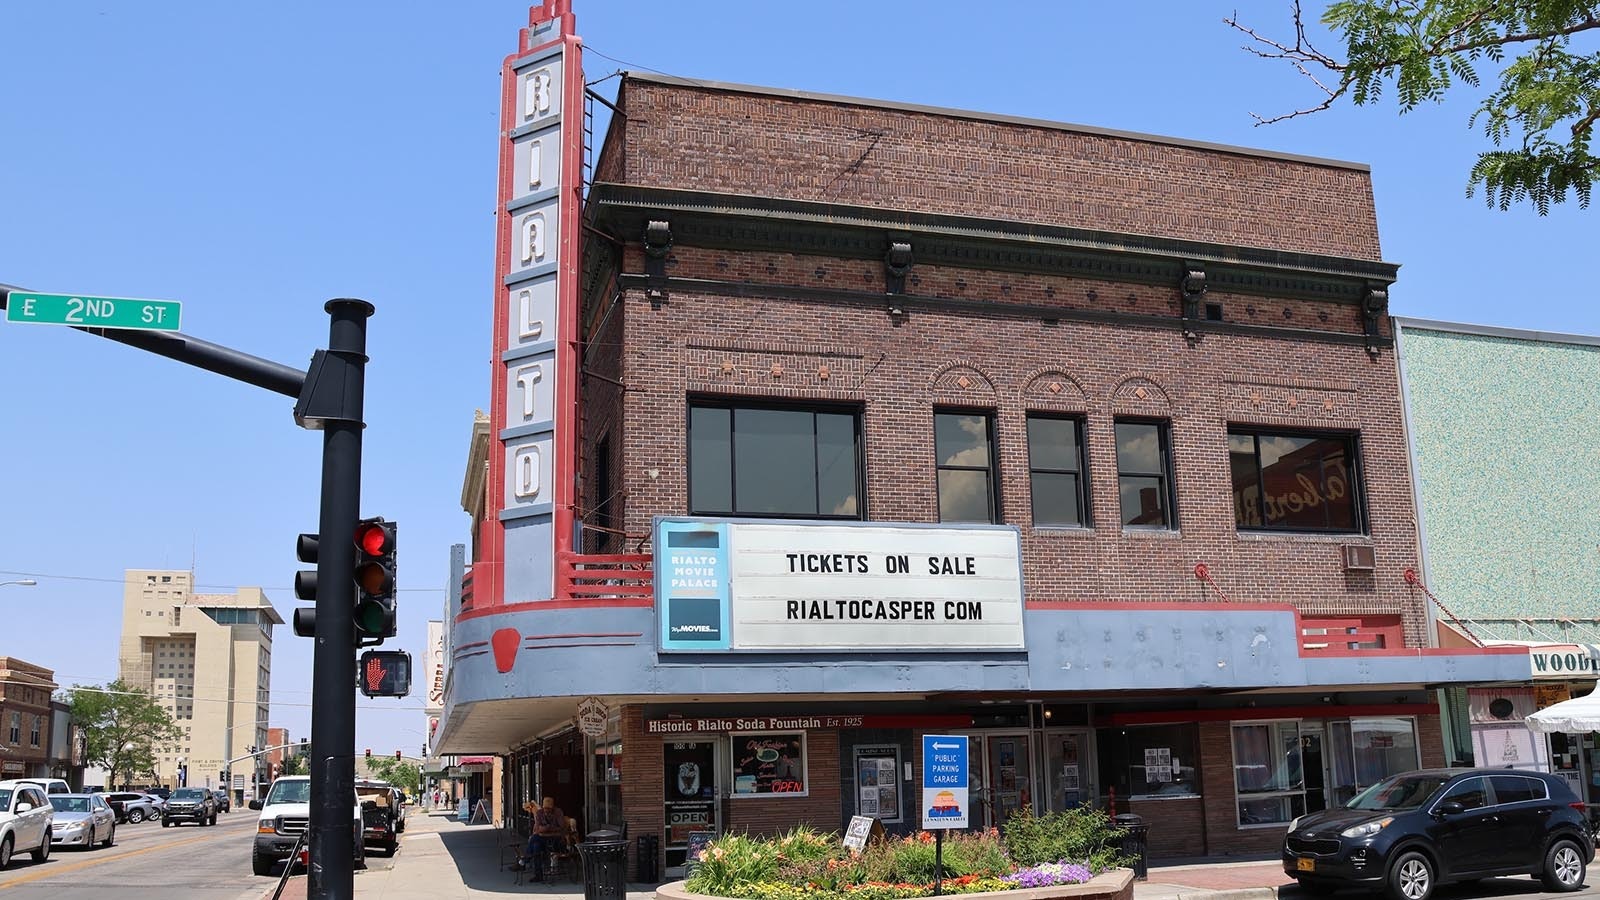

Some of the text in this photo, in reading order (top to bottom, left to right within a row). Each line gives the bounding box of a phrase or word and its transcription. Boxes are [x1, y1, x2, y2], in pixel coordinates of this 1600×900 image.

[514, 67, 552, 499] RIALTO
[23, 298, 167, 324] E 2ND ST
[671, 556, 717, 566] RIALTO
[786, 553, 976, 576] TICKETS ON SALE
[674, 567, 715, 577] MOVIE
[671, 578, 719, 588] PALACE
[786, 599, 983, 621] RIALTOCASPER COM
[648, 716, 863, 733] Historic Rialto Soda Fountain Est. 1925
[934, 754, 957, 763] PUBLIC
[932, 764, 960, 773] PARKING
[933, 775, 959, 783] GARAGE
[772, 781, 803, 794] OPEN
[671, 813, 708, 823] OPEN
